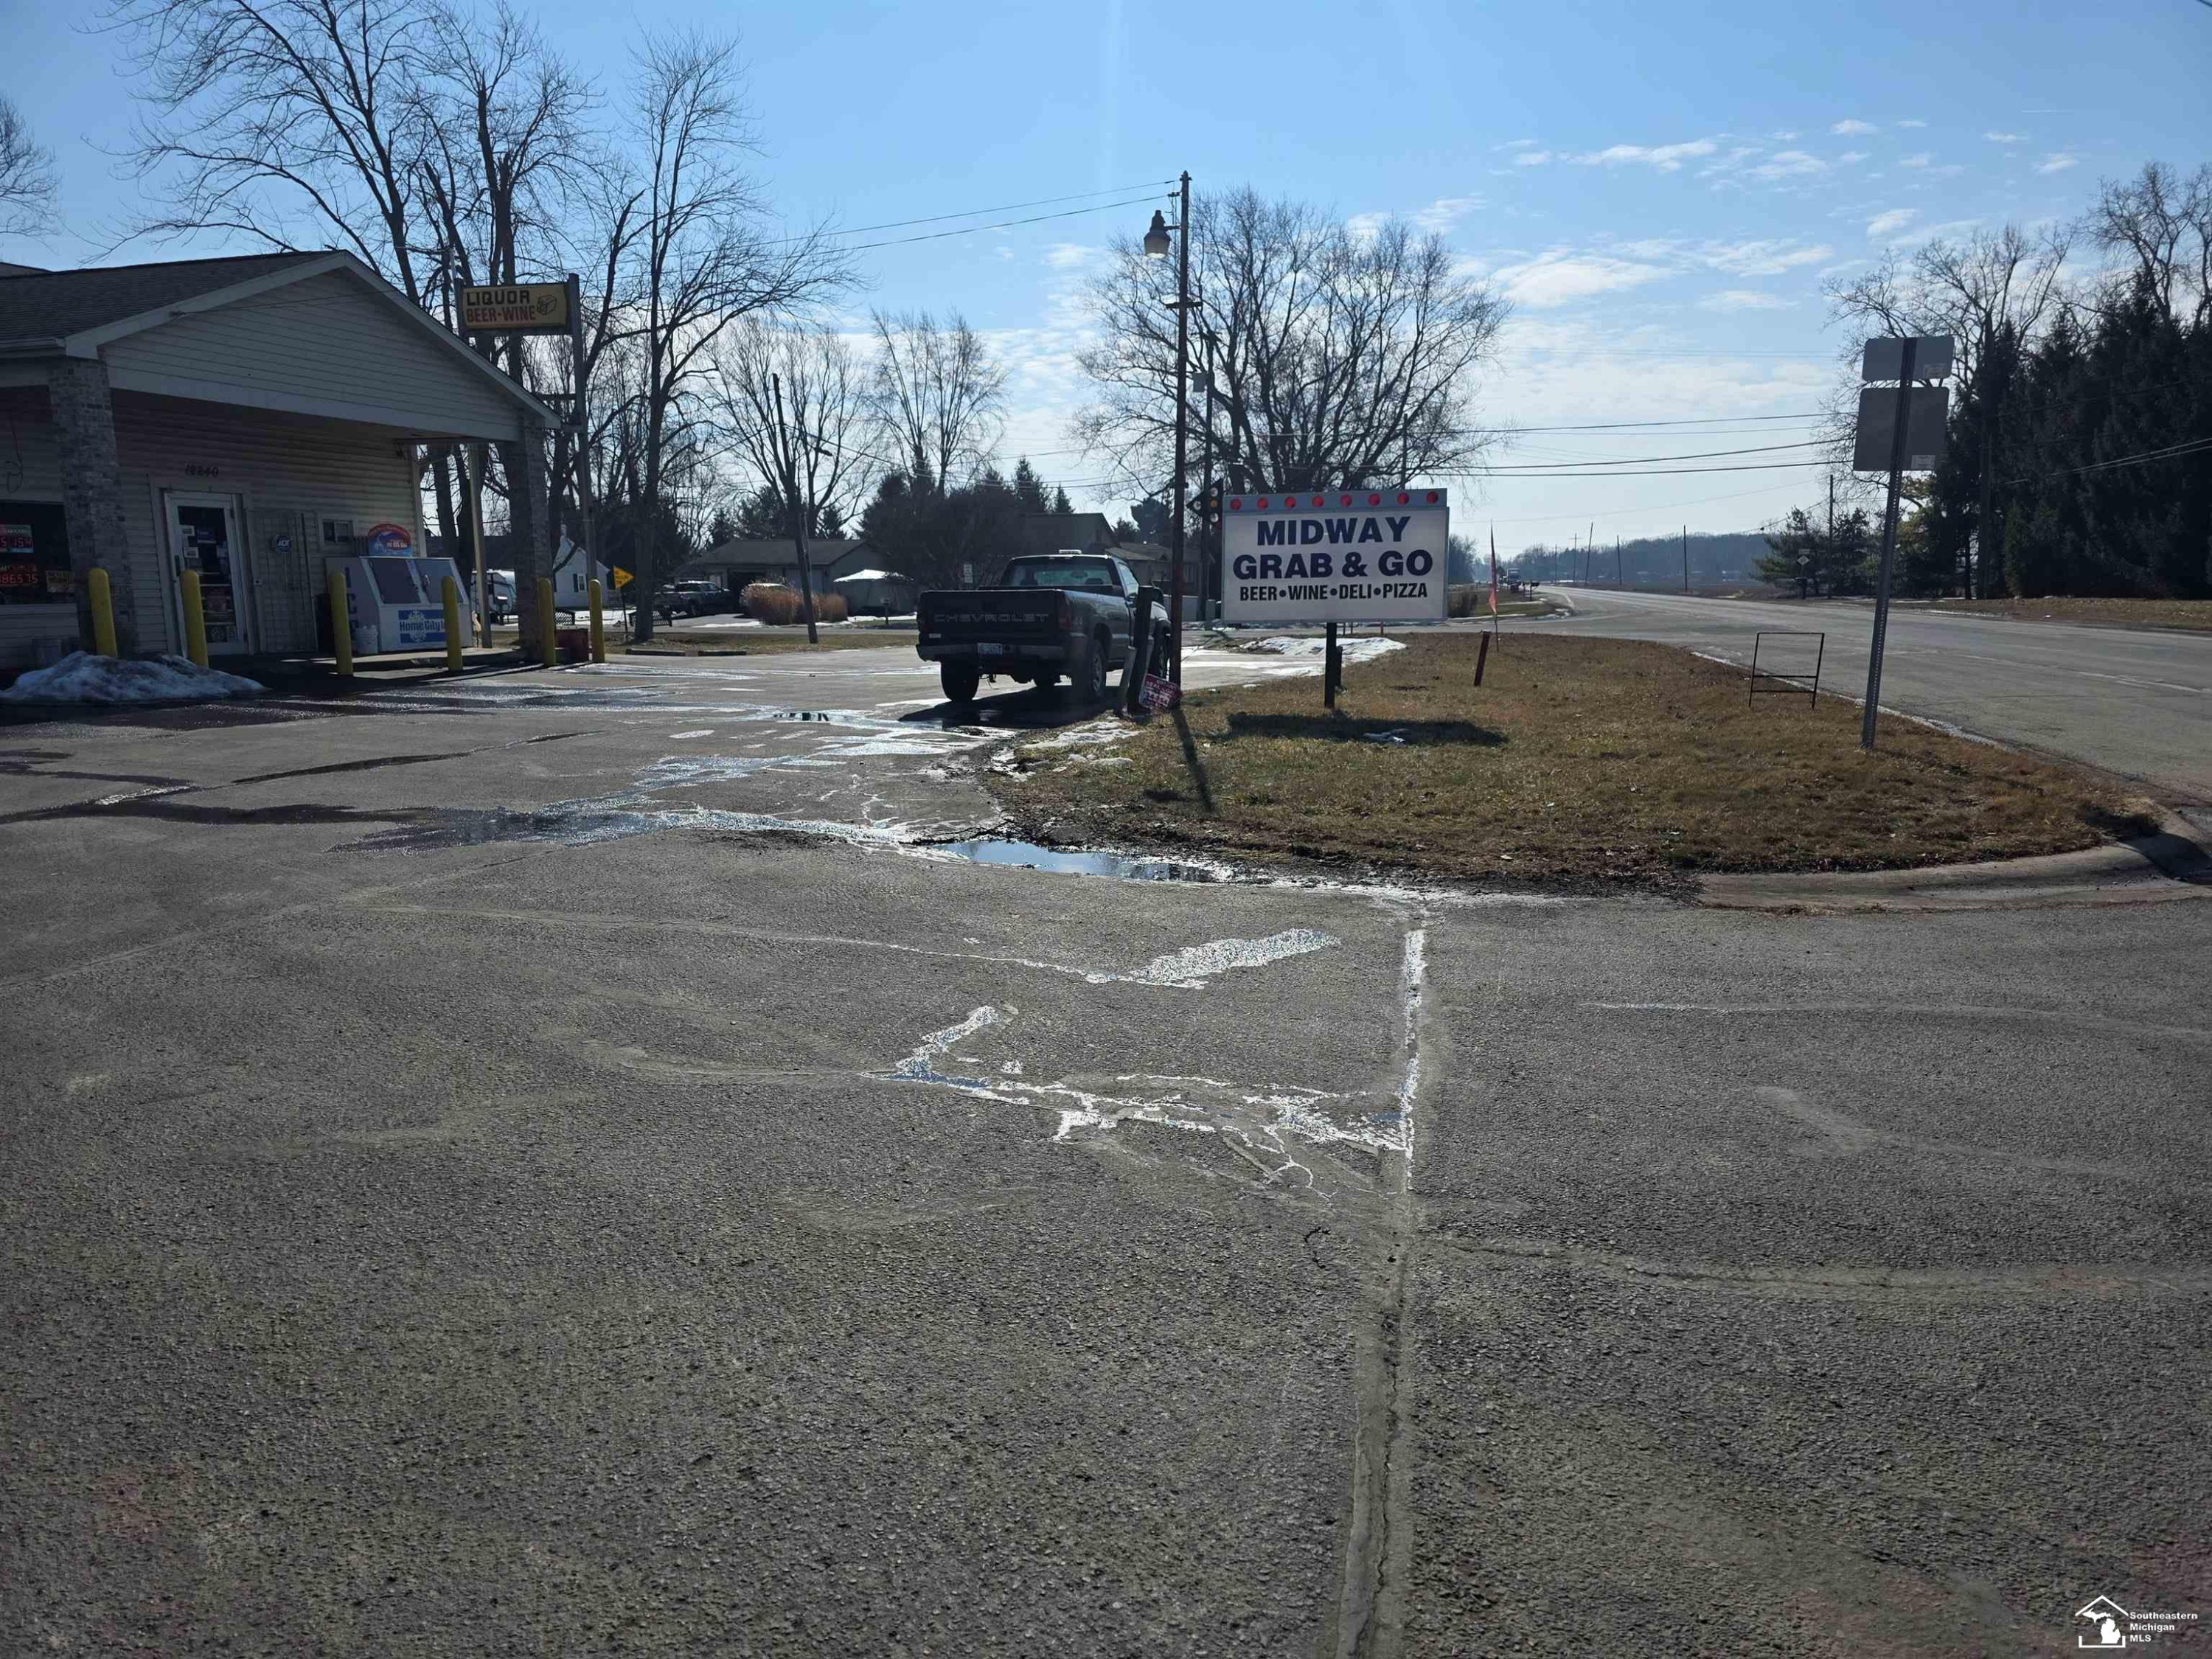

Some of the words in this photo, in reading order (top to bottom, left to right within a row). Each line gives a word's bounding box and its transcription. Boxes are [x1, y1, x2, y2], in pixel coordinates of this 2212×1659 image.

[466, 290, 530, 306] LIQUOR
[1257, 516, 1411, 546] MIDWAY
[1233, 553, 1333, 580] GRAB
[1341, 552, 1368, 577] &
[1378, 549, 1433, 577] GO
[1240, 586, 1278, 601] BEER
[1288, 584, 1328, 601] WINE
[1339, 584, 1371, 599] DELI
[1383, 582, 1427, 599] PIZZA
[399, 621, 424, 632] Home
[424, 619, 441, 632] City
[933, 613, 1048, 623] CHEVROLET
